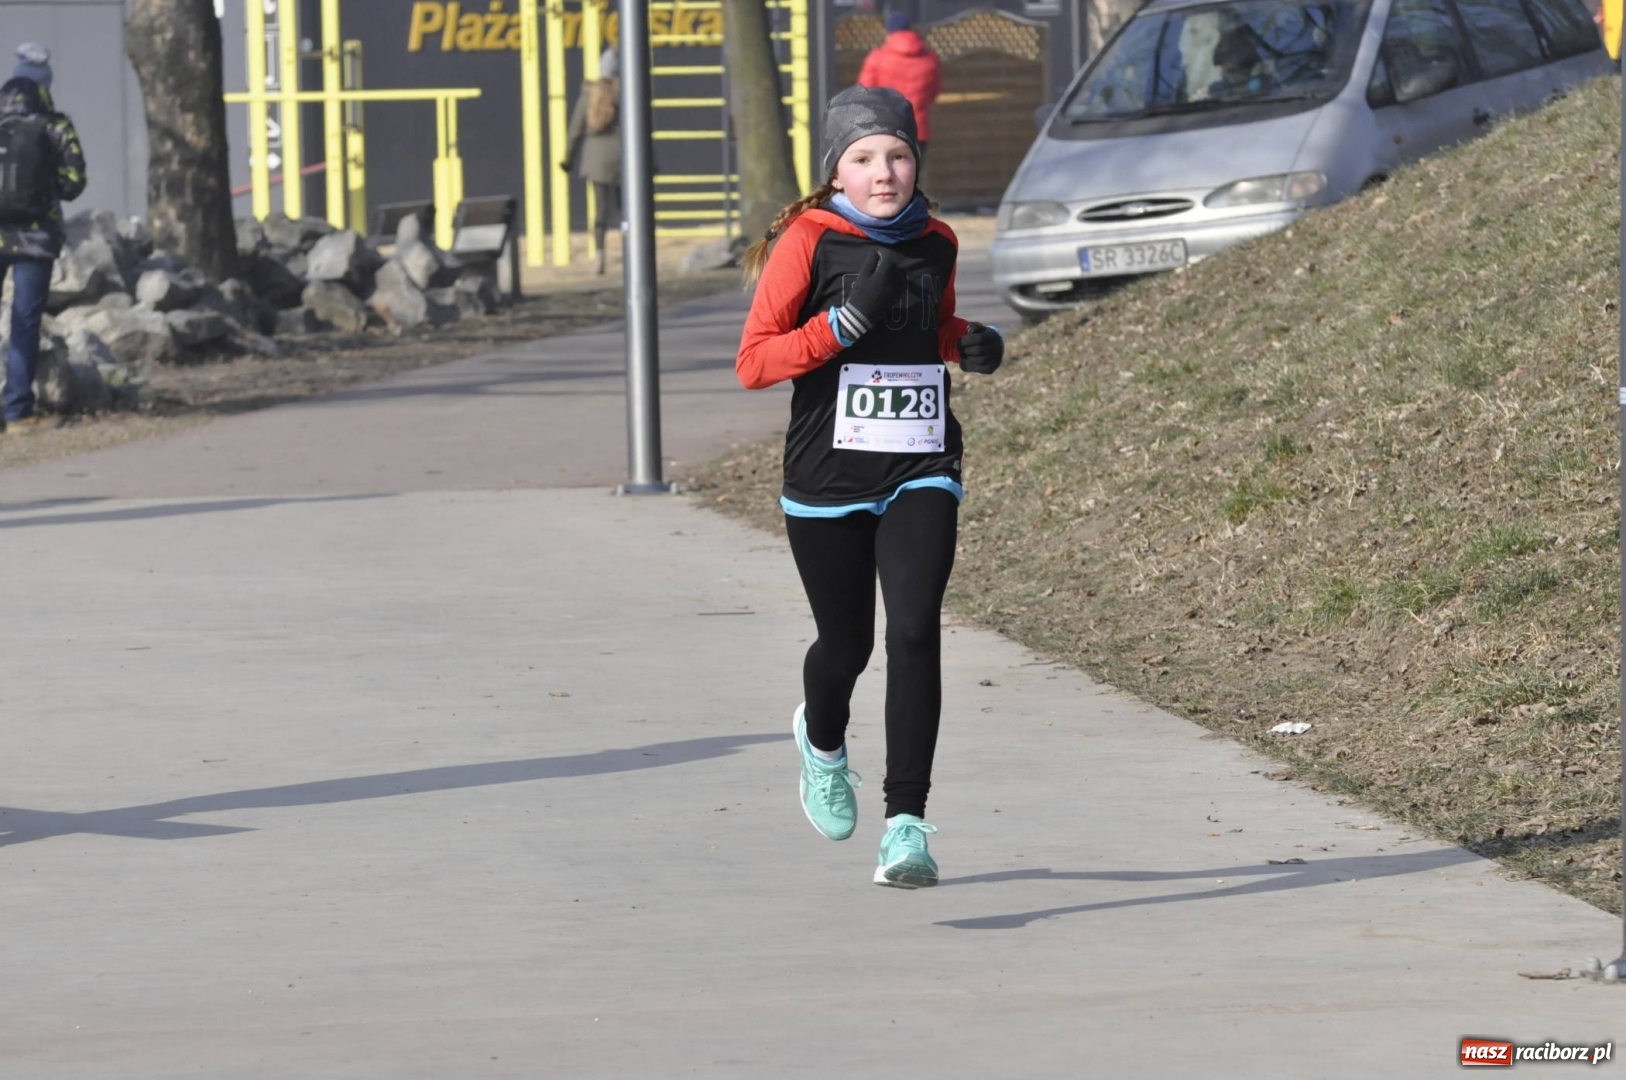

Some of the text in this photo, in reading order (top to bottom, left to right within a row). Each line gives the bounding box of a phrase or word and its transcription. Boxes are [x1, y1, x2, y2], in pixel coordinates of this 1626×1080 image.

[408, 1, 523, 51] Plaża
[1092, 242, 1181, 271] SR 3326C
[851, 387, 937, 419] 0128
